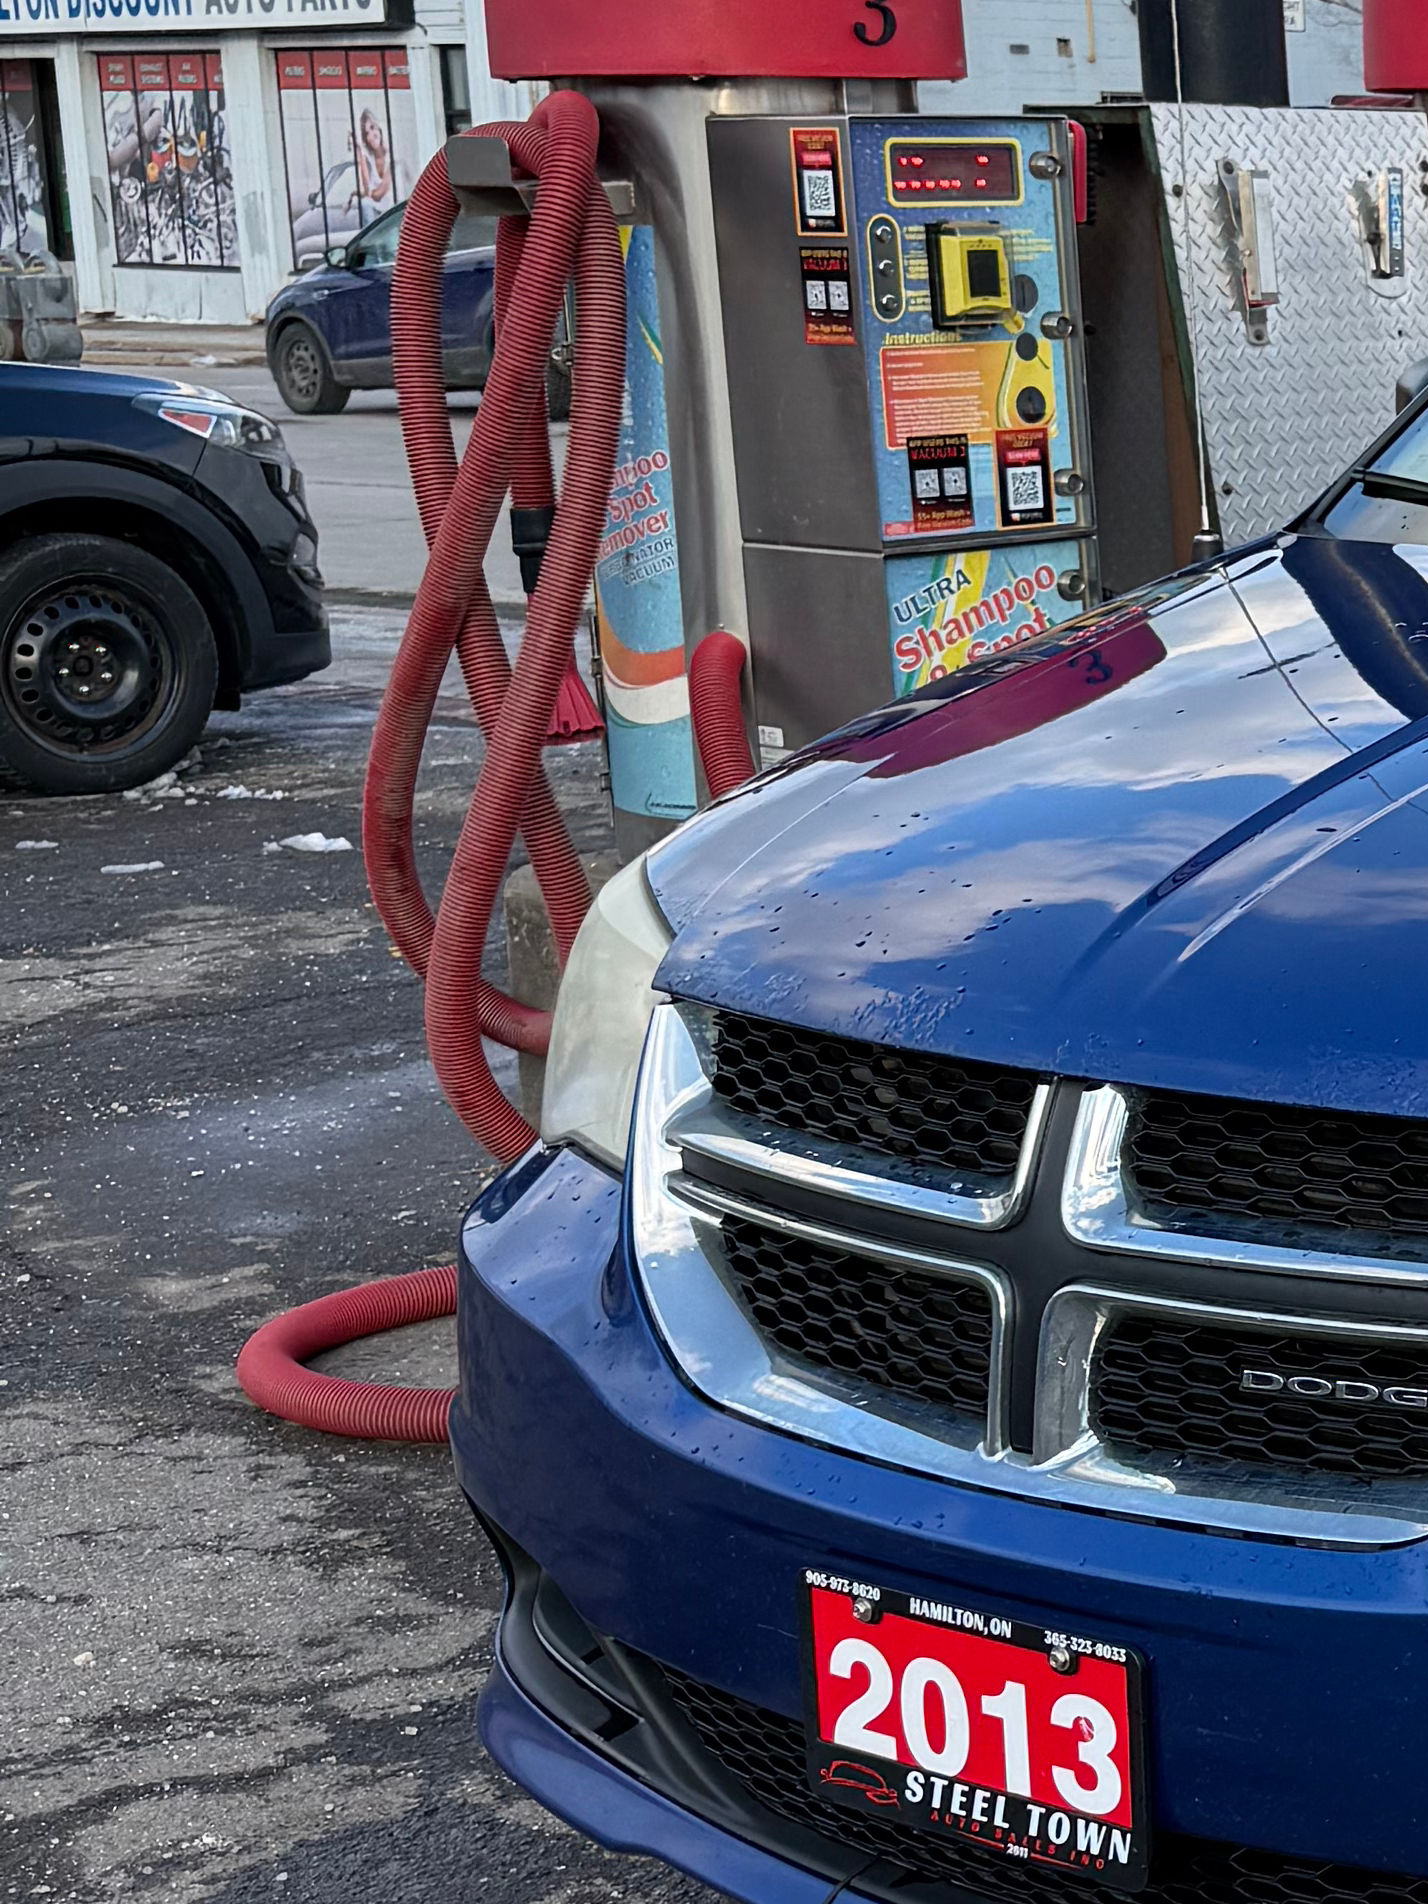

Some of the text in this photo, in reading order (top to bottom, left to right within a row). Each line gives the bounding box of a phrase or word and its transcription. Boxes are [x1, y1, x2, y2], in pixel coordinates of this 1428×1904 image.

[894, 569, 972, 624] ULTRA
[895, 565, 1055, 671] Shampoo
[829, 1637, 1122, 1815] 2013
[904, 1770, 1132, 1865] STEEL TOWN
[930, 1810, 981, 1833] AUTO
